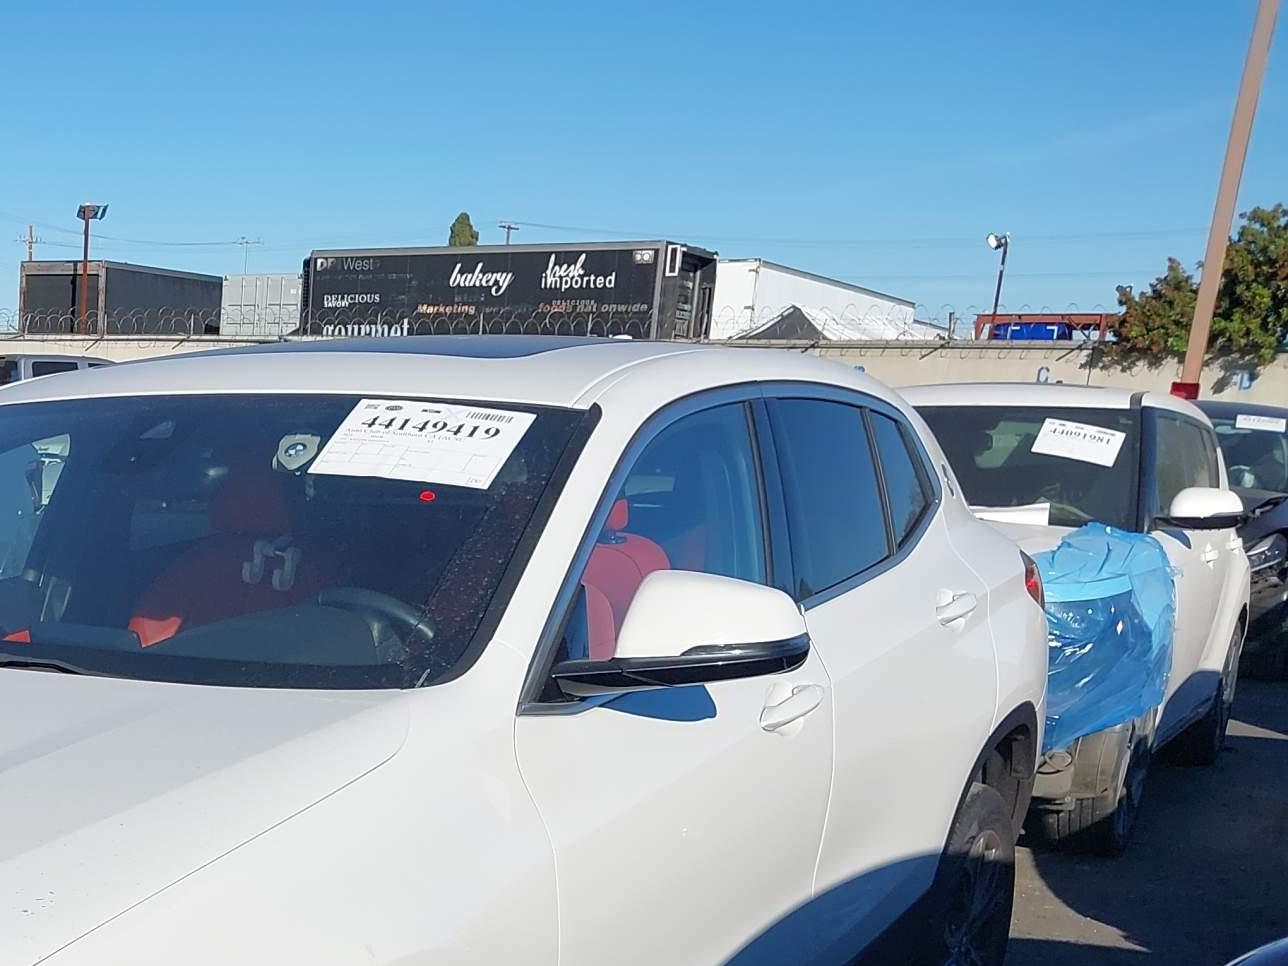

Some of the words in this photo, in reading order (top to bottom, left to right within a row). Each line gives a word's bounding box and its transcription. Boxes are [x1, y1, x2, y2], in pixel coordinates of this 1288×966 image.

[343, 257, 374, 271] West
[546, 252, 587, 285] fresh
[449, 262, 515, 296] bakery
[541, 271, 616, 292] imported
[324, 294, 380, 303] DELICIOUS
[417, 303, 476, 315] Marketing
[361, 415, 501, 440] 44149419
